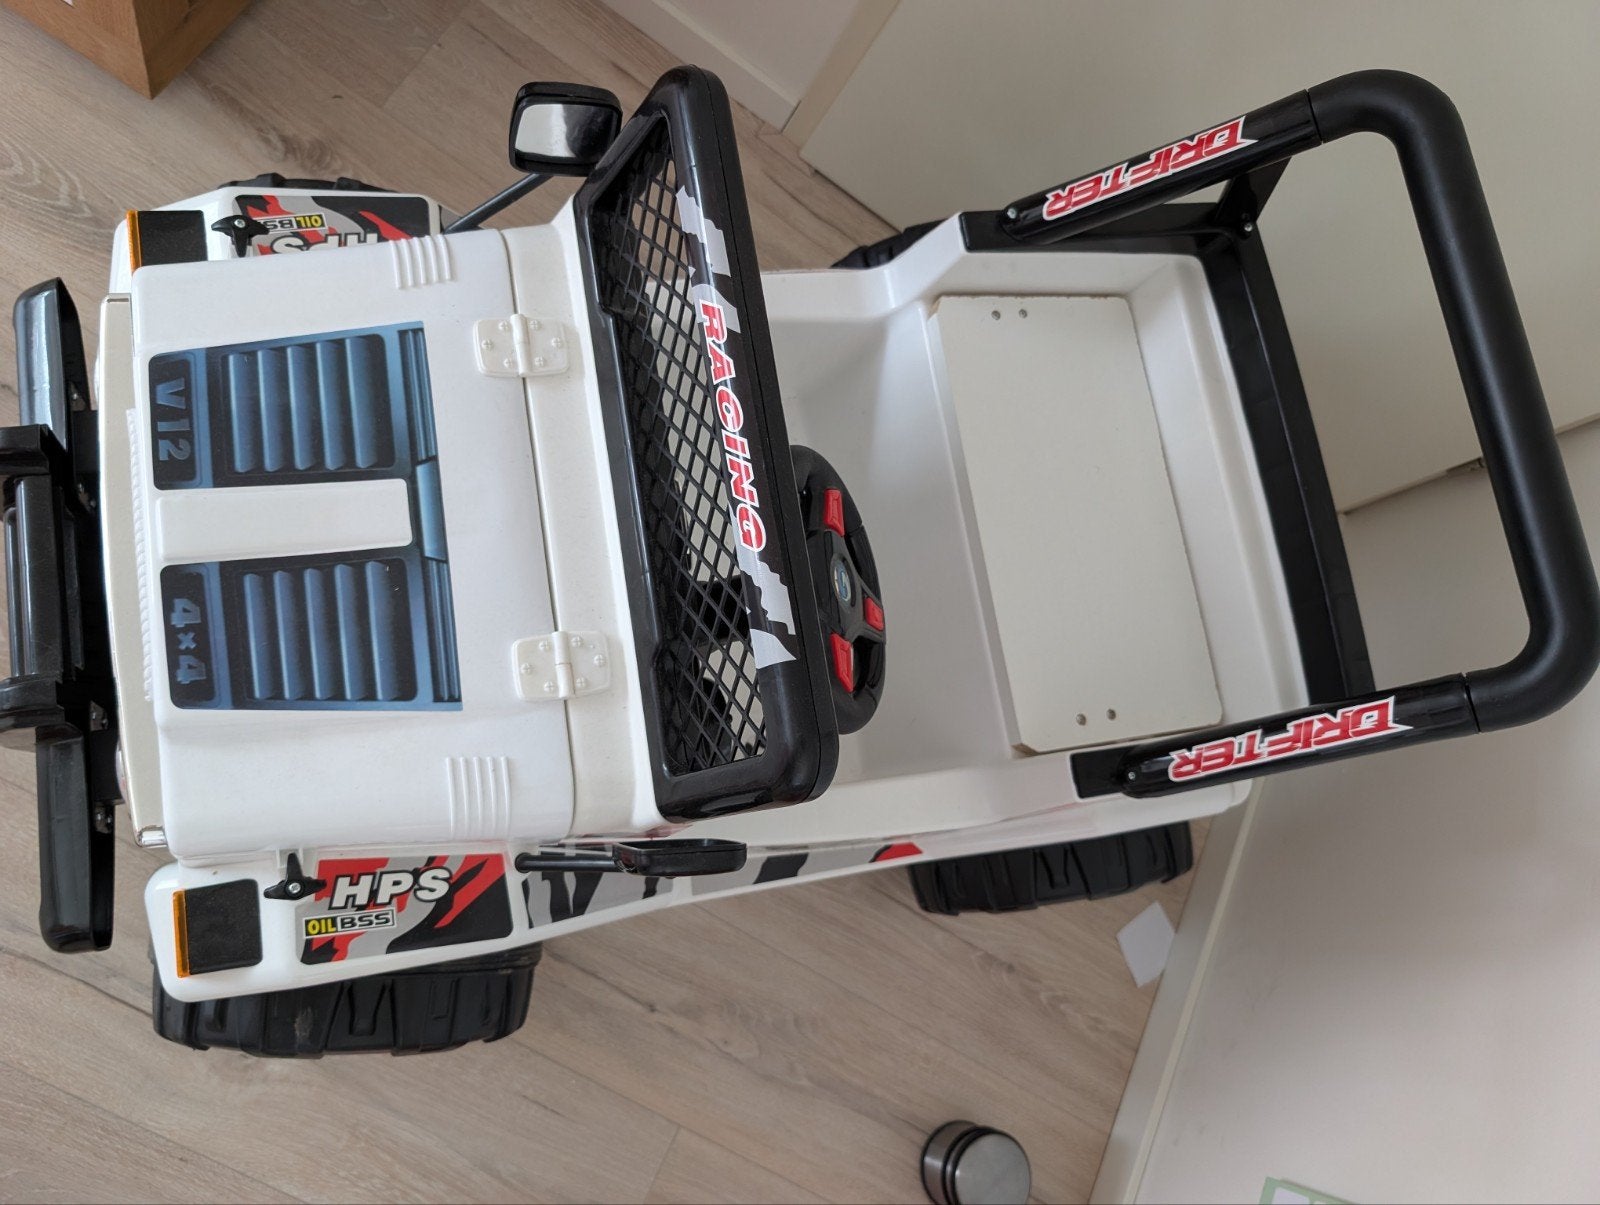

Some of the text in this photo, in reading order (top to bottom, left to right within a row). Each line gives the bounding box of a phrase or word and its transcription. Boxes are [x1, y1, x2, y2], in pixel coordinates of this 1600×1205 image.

[1042, 115, 1259, 220] DRIFTER
[263, 215, 322, 230] OIL BS
[155, 377, 191, 461] V12
[699, 299, 767, 553] RACING
[1167, 695, 1414, 783] DRIFTER
[307, 912, 390, 934] OIL BSS
[329, 867, 452, 909] HPS
